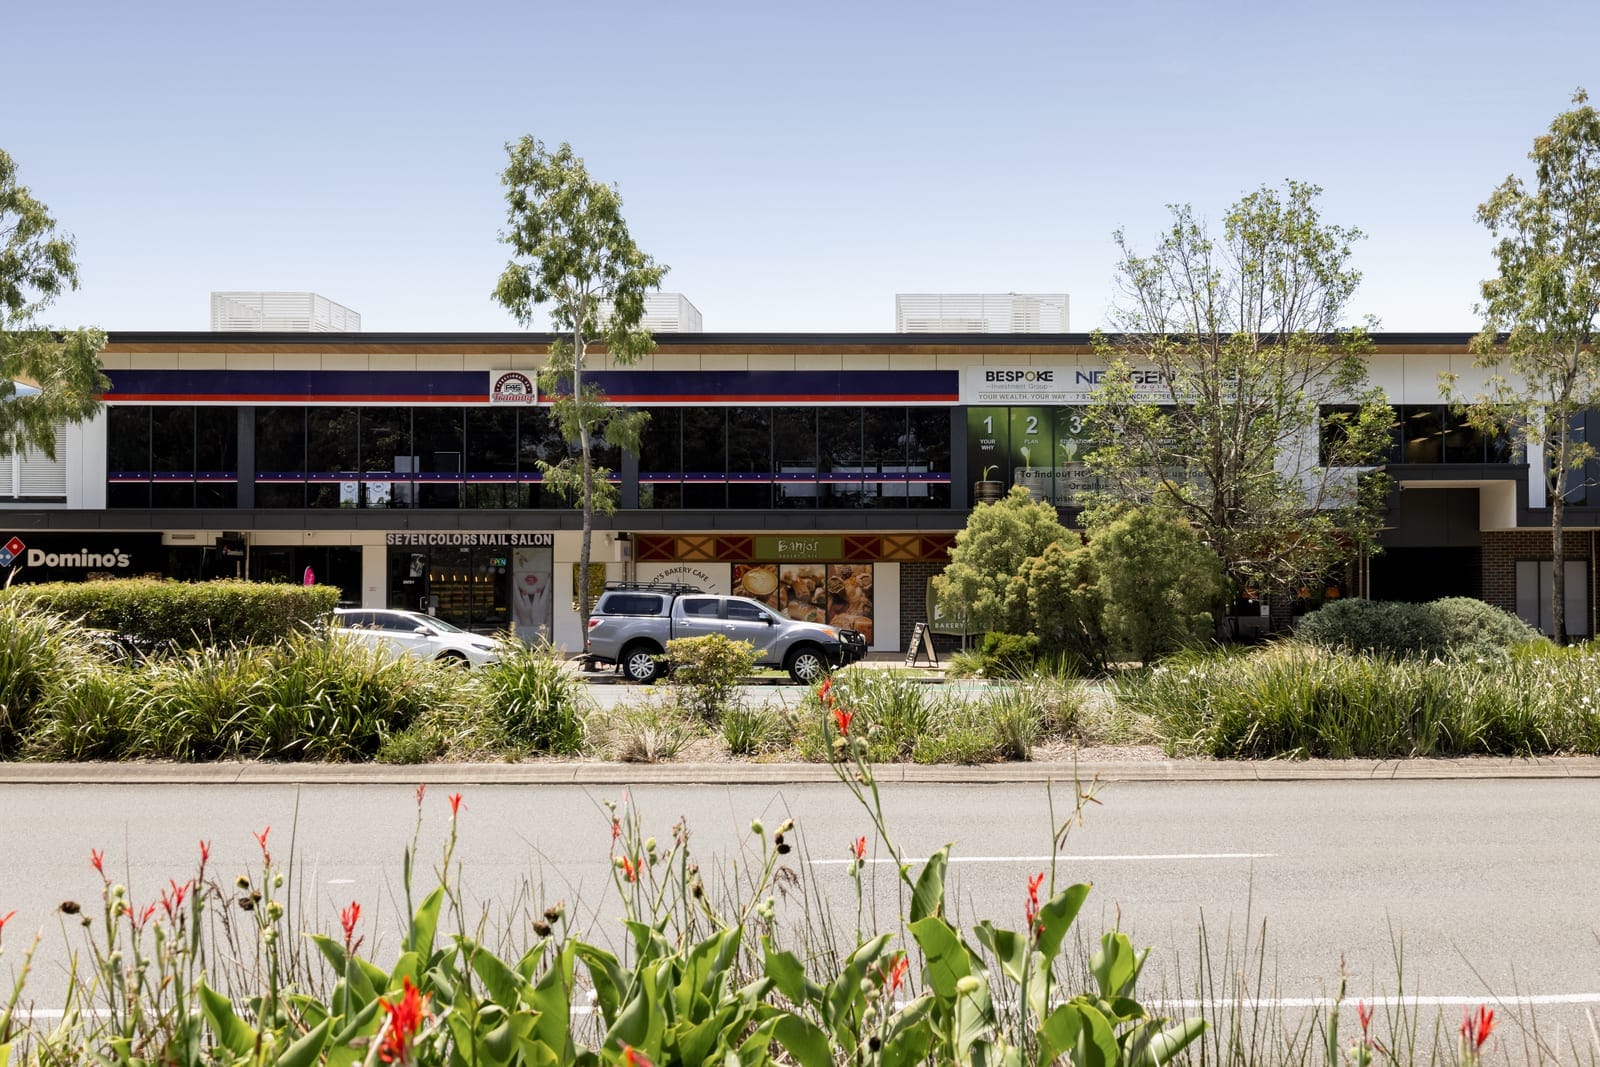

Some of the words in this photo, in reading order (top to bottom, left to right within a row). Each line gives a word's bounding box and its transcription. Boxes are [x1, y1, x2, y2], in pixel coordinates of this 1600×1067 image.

[985, 371, 1054, 382] BESPOKE
[983, 415, 993, 434] 1
[1026, 415, 1039, 434] 2
[1069, 415, 1082, 434] 3
[1021, 470, 1031, 478] To
[1034, 470, 1052, 478] find
[1055, 470, 1071, 478] out
[387, 534, 427, 545] SE7EN
[428, 534, 477, 545] COLORS
[479, 534, 509, 545] NAIL
[511, 534, 552, 545] SALON
[27, 548, 130, 567] Domino's
[490, 558, 507, 567] OPEN
[664, 566, 692, 577] BAKERY
[692, 569, 709, 582] CAFE
